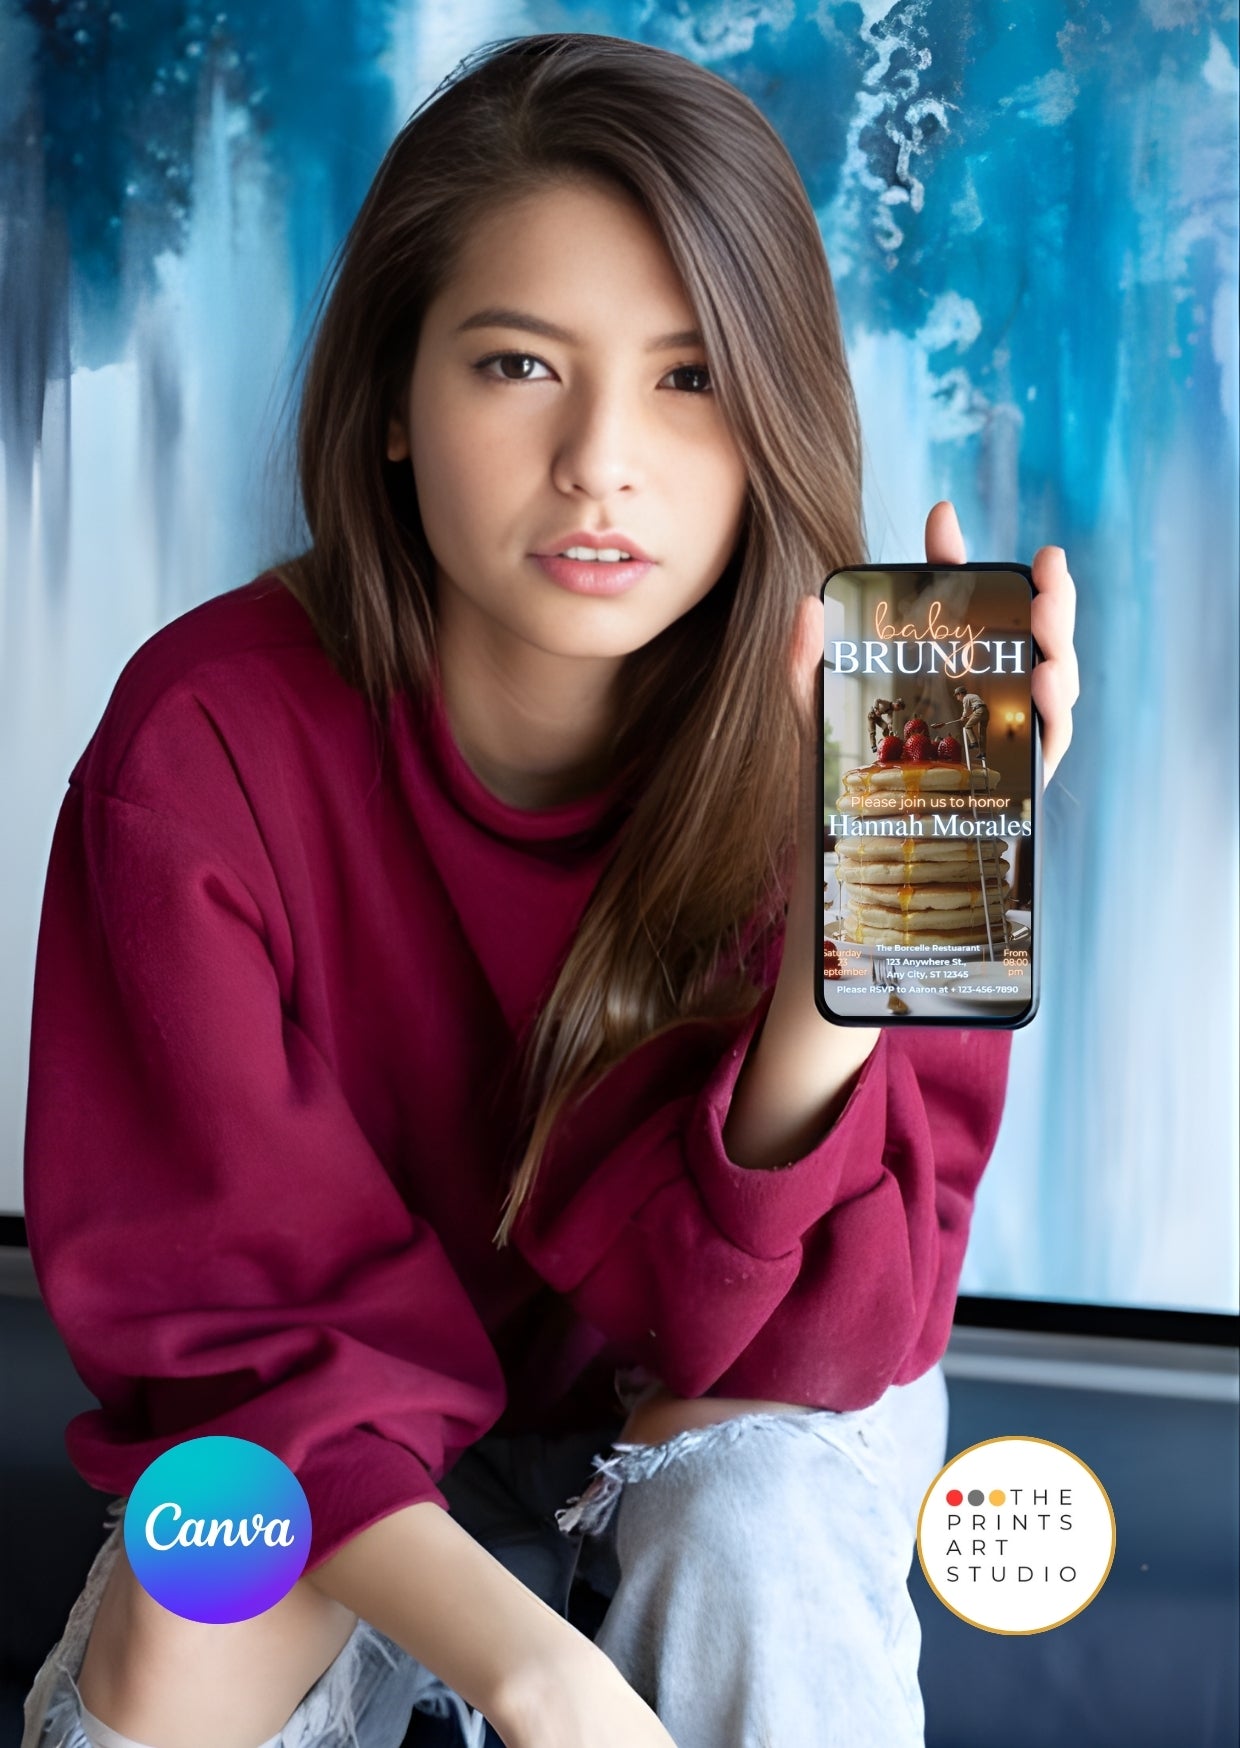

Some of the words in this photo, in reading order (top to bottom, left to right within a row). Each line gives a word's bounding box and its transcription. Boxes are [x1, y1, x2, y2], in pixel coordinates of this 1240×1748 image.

[874, 601, 985, 679] baby
[831, 640, 1026, 674] BRUNCH
[851, 796, 897, 808] Please
[898, 795, 926, 811] join
[930, 798, 947, 808] us
[950, 797, 965, 808] to
[968, 796, 1011, 808] honor
[828, 814, 924, 837] Hannah
[931, 814, 1032, 837] Morales
[876, 944, 893, 952] The
[894, 944, 930, 952] Borcelle
[932, 944, 981, 952] Restuarant
[1003, 949, 1028, 957] From
[886, 958, 901, 966] 123
[902, 958, 951, 968] Anywhere
[1002, 958, 1029, 967] 08:00
[823, 967, 867, 977] eptember
[886, 970, 904, 979] Any
[907, 969, 928, 980] City,
[929, 970, 941, 978] ST
[943, 970, 969, 978] 12345
[1008, 969, 1024, 977] pm
[836, 985, 867, 994] Please
[869, 985, 895, 994] RSVP
[896, 986, 907, 994] to
[908, 985, 937, 994] Aaron
[938, 986, 949, 994] at
[958, 985, 1019, 994] 123-456-7890
